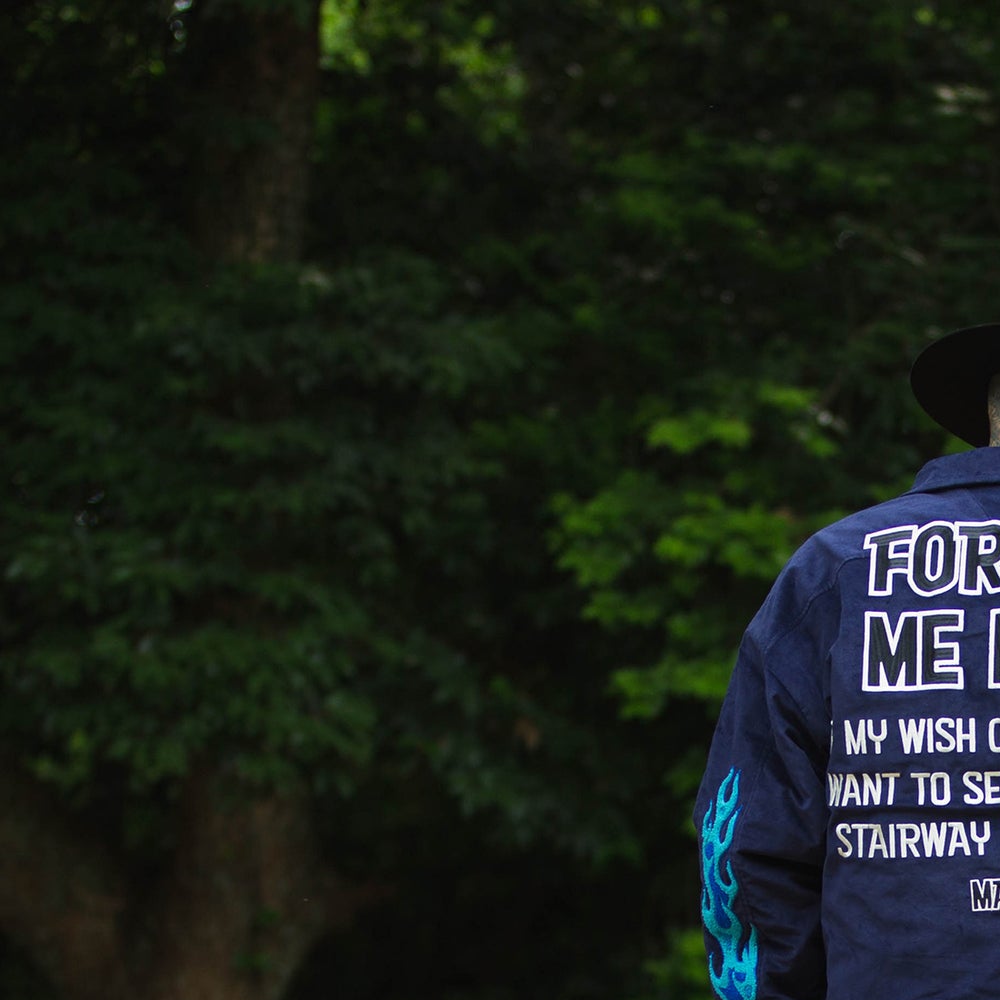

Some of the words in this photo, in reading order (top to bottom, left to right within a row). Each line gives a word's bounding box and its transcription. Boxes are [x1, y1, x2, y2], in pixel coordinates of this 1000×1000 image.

[862, 608, 965, 692] ME
[843, 717, 888, 756] MY
[898, 716, 977, 755] WISH
[827, 772, 901, 808] WANT
[911, 771, 951, 807] TO
[835, 820, 992, 860] STAIRWAY
